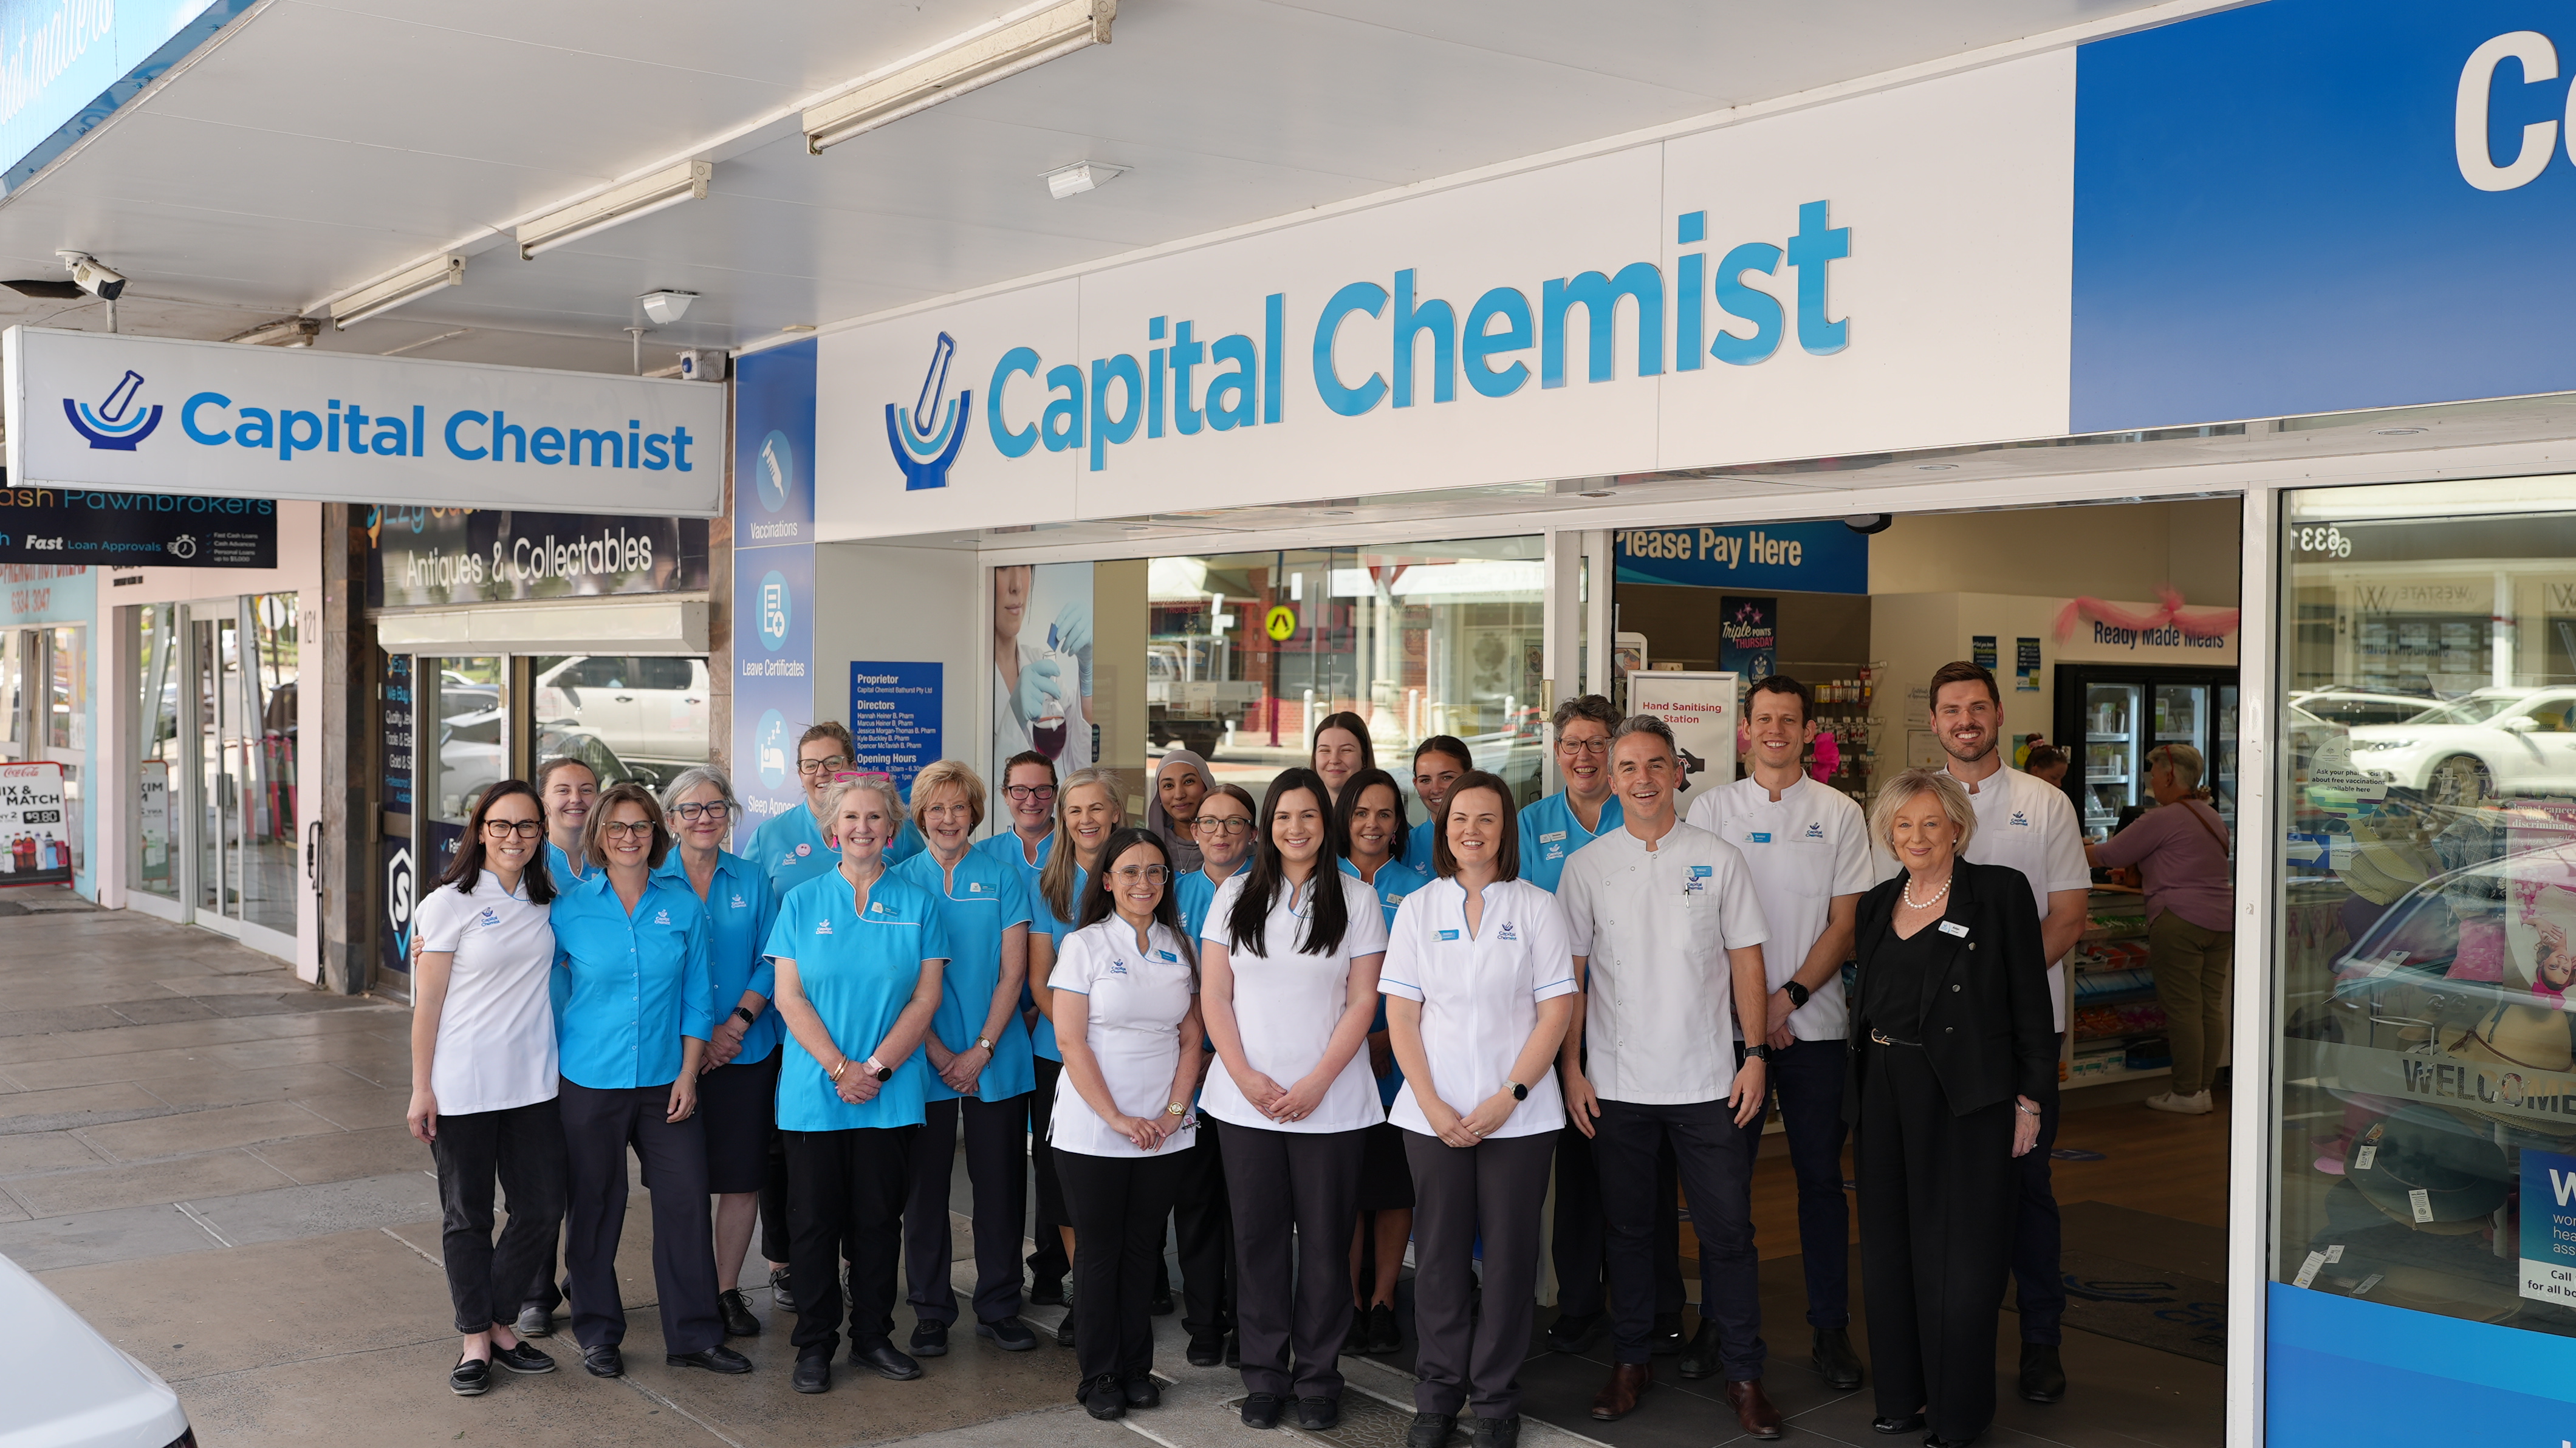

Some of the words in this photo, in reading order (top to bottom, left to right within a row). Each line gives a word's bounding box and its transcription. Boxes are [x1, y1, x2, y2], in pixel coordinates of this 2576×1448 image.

[2455, 30, 2576, 191] C
[987, 292, 1286, 472] Capital
[1312, 200, 1851, 418] Chemist
[180, 392, 425, 460] Capital
[444, 410, 693, 472] Chemist
[64, 490, 272, 515] Pawnbrokers
[750, 520, 798, 539] Vaccinations
[26, 534, 63, 550] Fast
[68, 541, 98, 550] Loan
[101, 541, 162, 552] Approvals
[1699, 528, 1742, 569] Pay
[1750, 531, 1802, 566] Here
[406, 547, 483, 593] Antiques
[492, 541, 505, 583] &
[513, 527, 653, 581] Collectables
[304, 610, 316, 644] 121
[1722, 620, 1752, 643] Triple
[1752, 628, 1771, 637] POINTS
[2094, 620, 2137, 650] Ready
[2143, 625, 2180, 646] Made
[2185, 627, 2224, 648] Meals
[1735, 636, 1774, 649] THURSDAY
[743, 659, 763, 677] Leave
[765, 658, 805, 677] Certificates
[857, 674, 899, 685] Proprietor
[857, 700, 895, 710] Directors
[1643, 702, 1670, 711] Hand
[1673, 702, 1722, 714] Sanitising
[1663, 714, 1699, 723] Station
[857, 754, 891, 765] Opening
[893, 754, 917, 763] Hours
[22, 785, 31, 794] &
[7, 794, 60, 806] MATCH
[748, 794, 767, 817] Sleep
[2543, 805, 2576, 814] cancer
[26, 811, 58, 823] $9.80
[2526, 813, 2560, 821] doesn't
[2512, 819, 2575, 831] discriminate
[2527, 833, 2544, 846] here
[2402, 1058, 2576, 1115] WELCOME
[2551, 1270, 2571, 1282] Call
[2527, 1280, 2544, 1290] for
[2547, 1285, 2560, 1294] all
